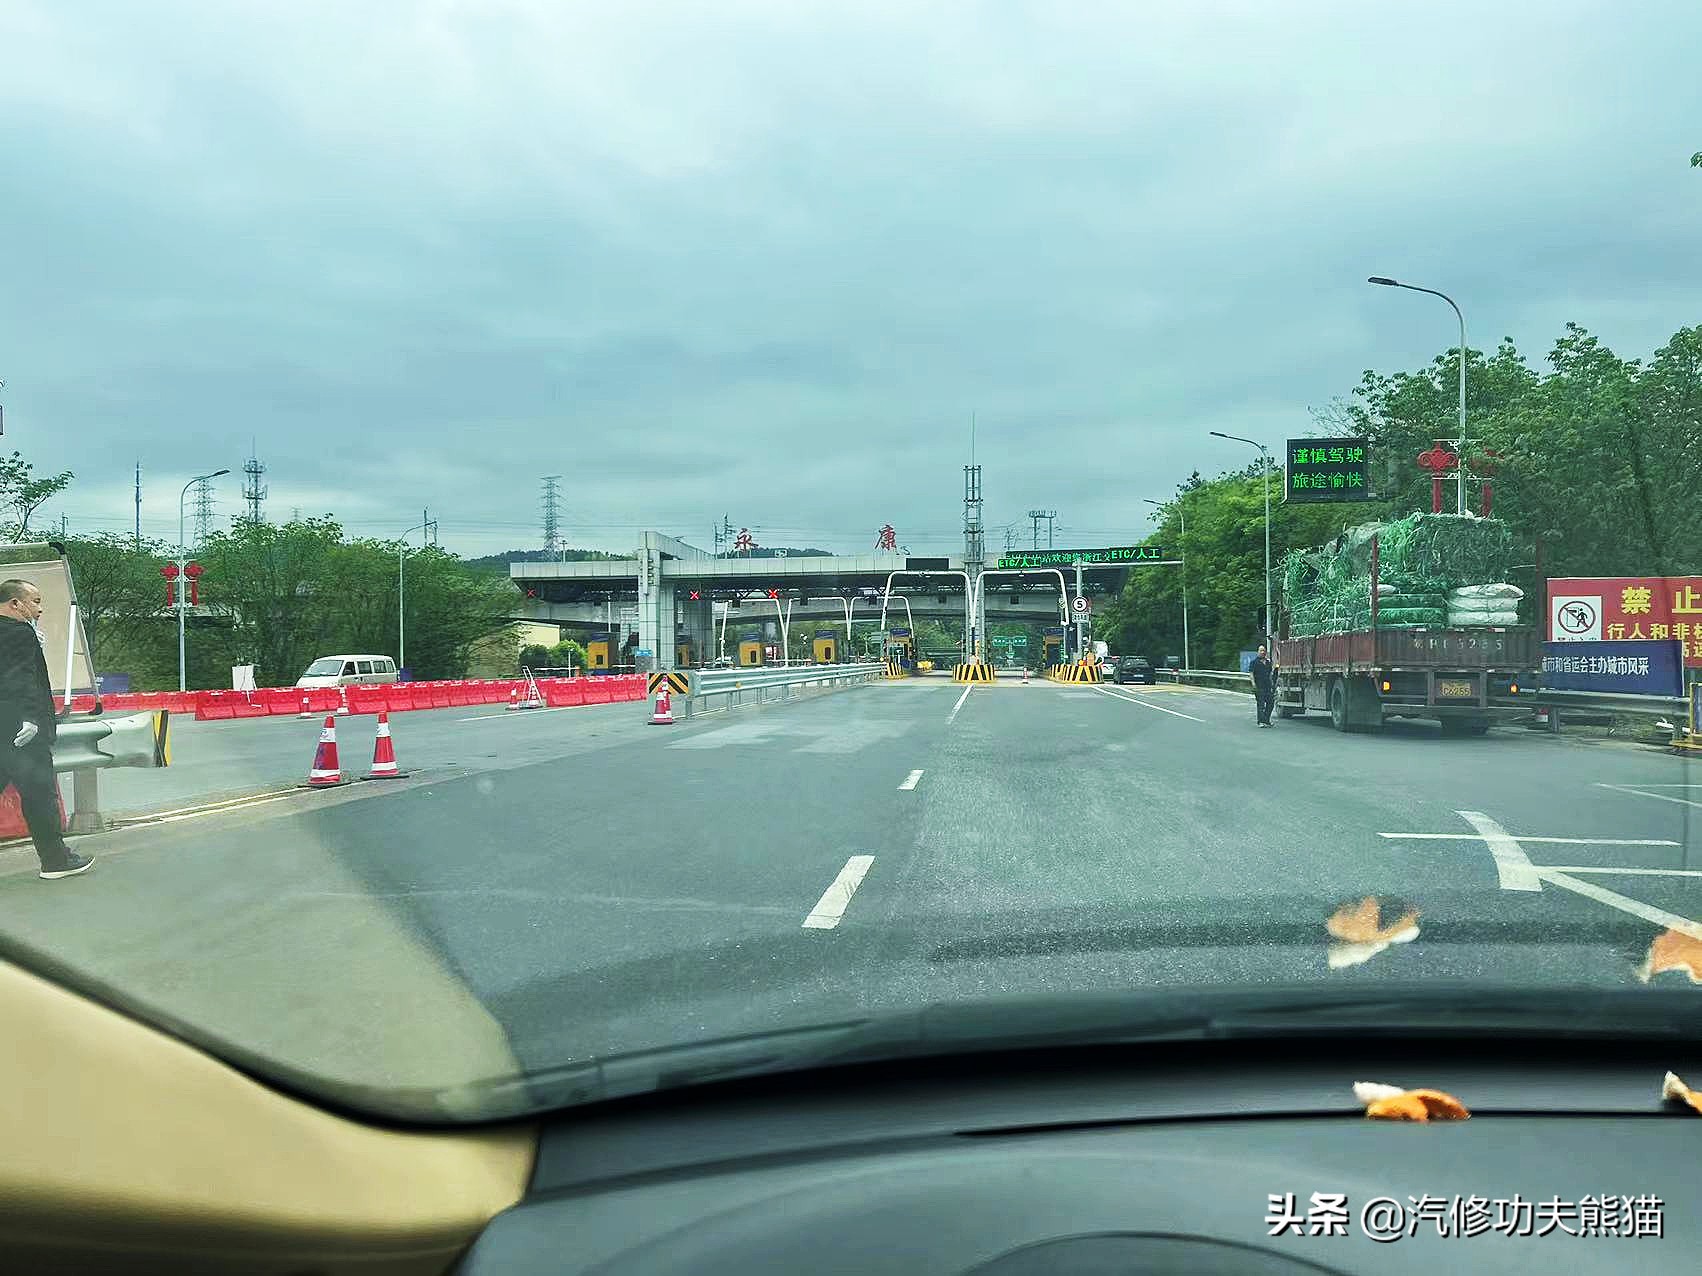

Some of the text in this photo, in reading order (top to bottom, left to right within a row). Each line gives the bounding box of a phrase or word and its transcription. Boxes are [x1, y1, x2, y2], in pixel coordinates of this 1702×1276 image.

[1292, 447, 1363, 464] 谨慎驾驶
[1292, 471, 1363, 489] 旅途愉快
[1111, 548, 1160, 559] ETC/人工
[998, 557, 1040, 568] ETC/人工
[1077, 600, 1083, 609] 5
